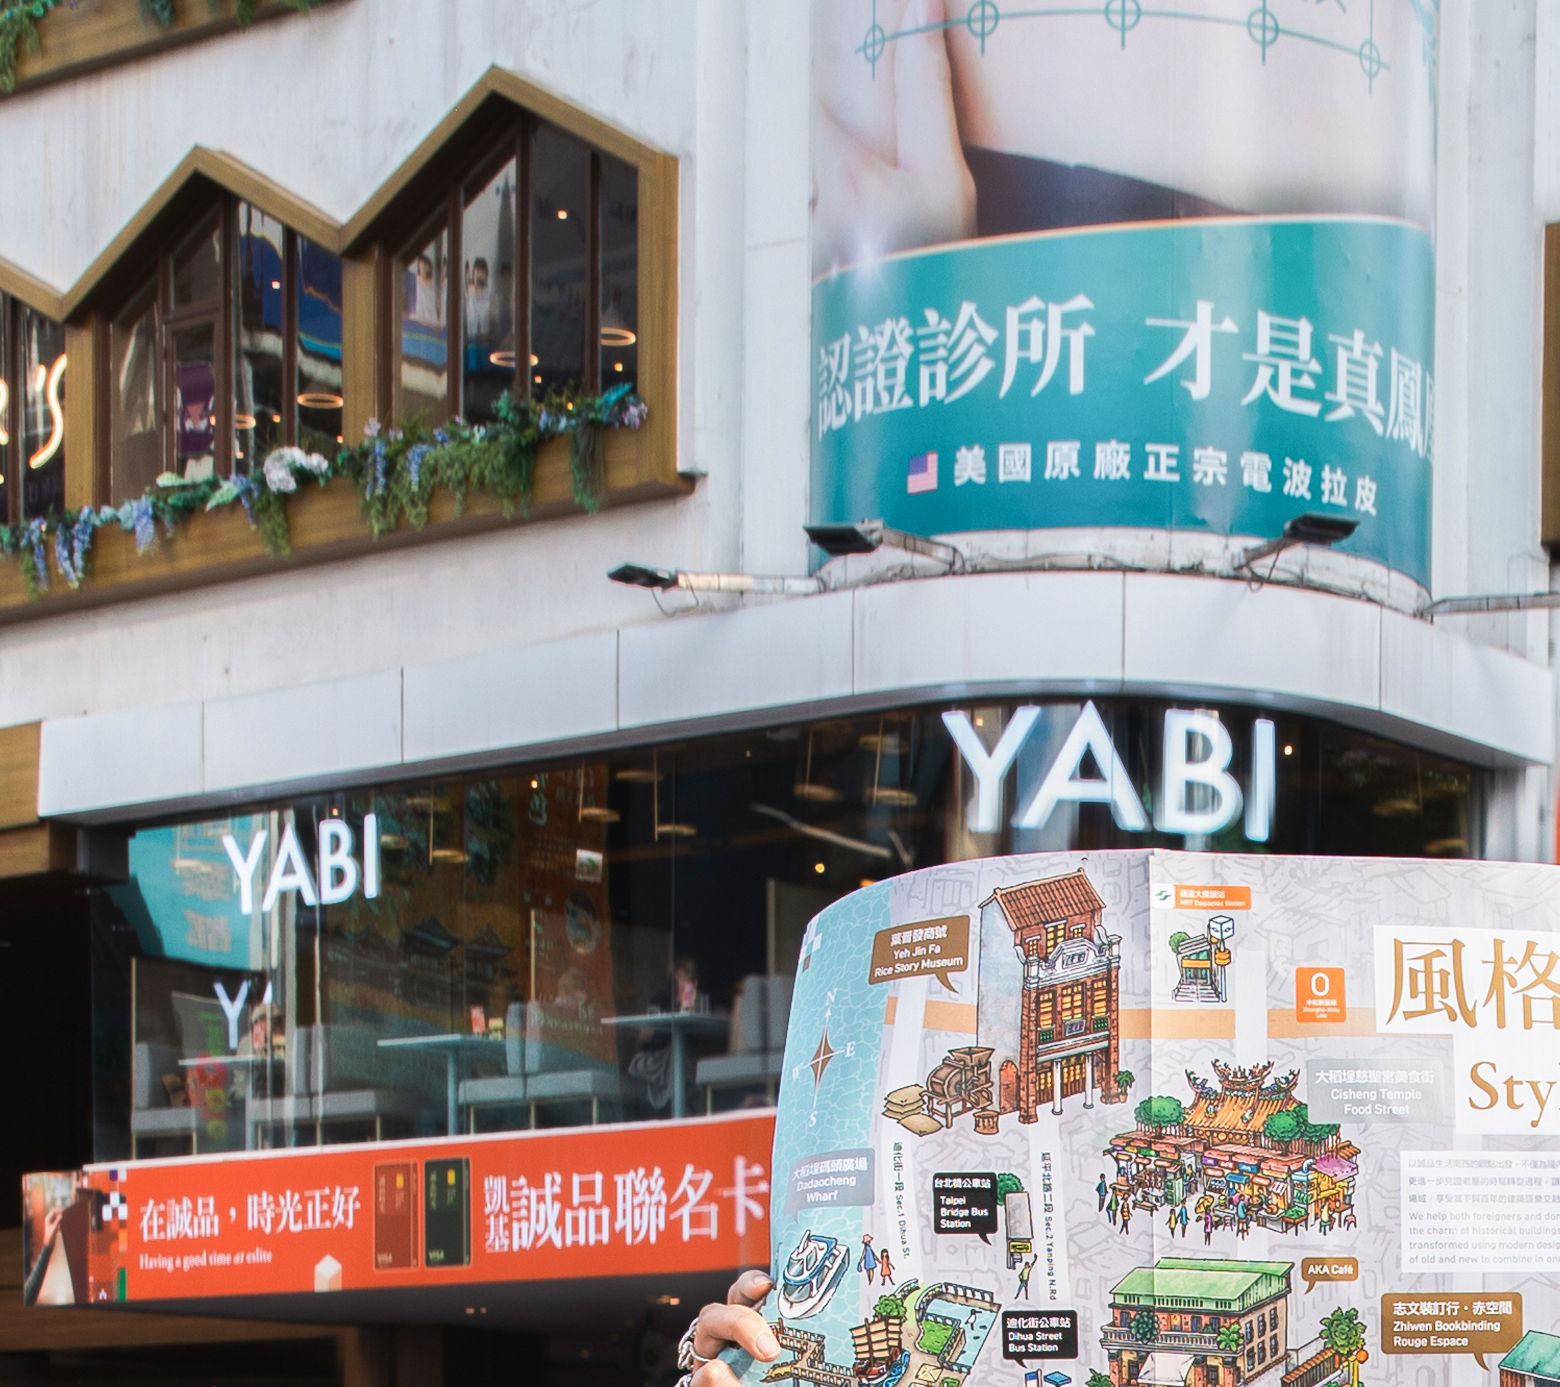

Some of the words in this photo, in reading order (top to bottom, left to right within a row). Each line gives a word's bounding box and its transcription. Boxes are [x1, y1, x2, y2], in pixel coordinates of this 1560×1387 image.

[818, 294, 1096, 442] 認證診所
[954, 438, 1378, 516] 美國原廠正宗電波拉皮
[940, 699, 1277, 842] YABI
[222, 813, 379, 915] YABI
[894, 950, 910, 959] Yeh
[912, 947, 926, 956] Jin
[929, 944, 941, 954] Fa
[875, 967, 893, 977] Rice
[894, 962, 919, 973] Story
[921, 957, 963, 969] Museum
[1331, 1088, 1368, 1102] Cisheng
[1370, 1088, 1422, 1101] Temple
[1344, 1104, 1371, 1115] Food
[1375, 1103, 1409, 1115] Street
[796, 1174, 856, 1192] Dadaocheng
[807, 1190, 838, 1202] Wharf
[940, 1195, 966, 1207] Taipei
[510, 1155, 770, 1252] 誠品聯名卡
[940, 1206, 968, 1217] Bridge
[971, 1207, 988, 1216] Bus
[940, 1218, 971, 1229] Station
[139, 1251, 174, 1273] Having
[183, 1250, 207, 1271] good
[209, 1249, 230, 1265] time
[1308, 1264, 1330, 1275] AKA
[1331, 1263, 1354, 1275] Café
[1393, 1320, 1432, 1332] Zhiwen
[1435, 1320, 1500, 1333] Bookbinding
[1008, 1331, 1031, 1342] Dihua
[1034, 1331, 1063, 1342] Street
[1394, 1336, 1426, 1348] Rouge
[1430, 1336, 1468, 1348] Espace
[1009, 1342, 1027, 1353] Bus
[1029, 1342, 1058, 1353] Station
